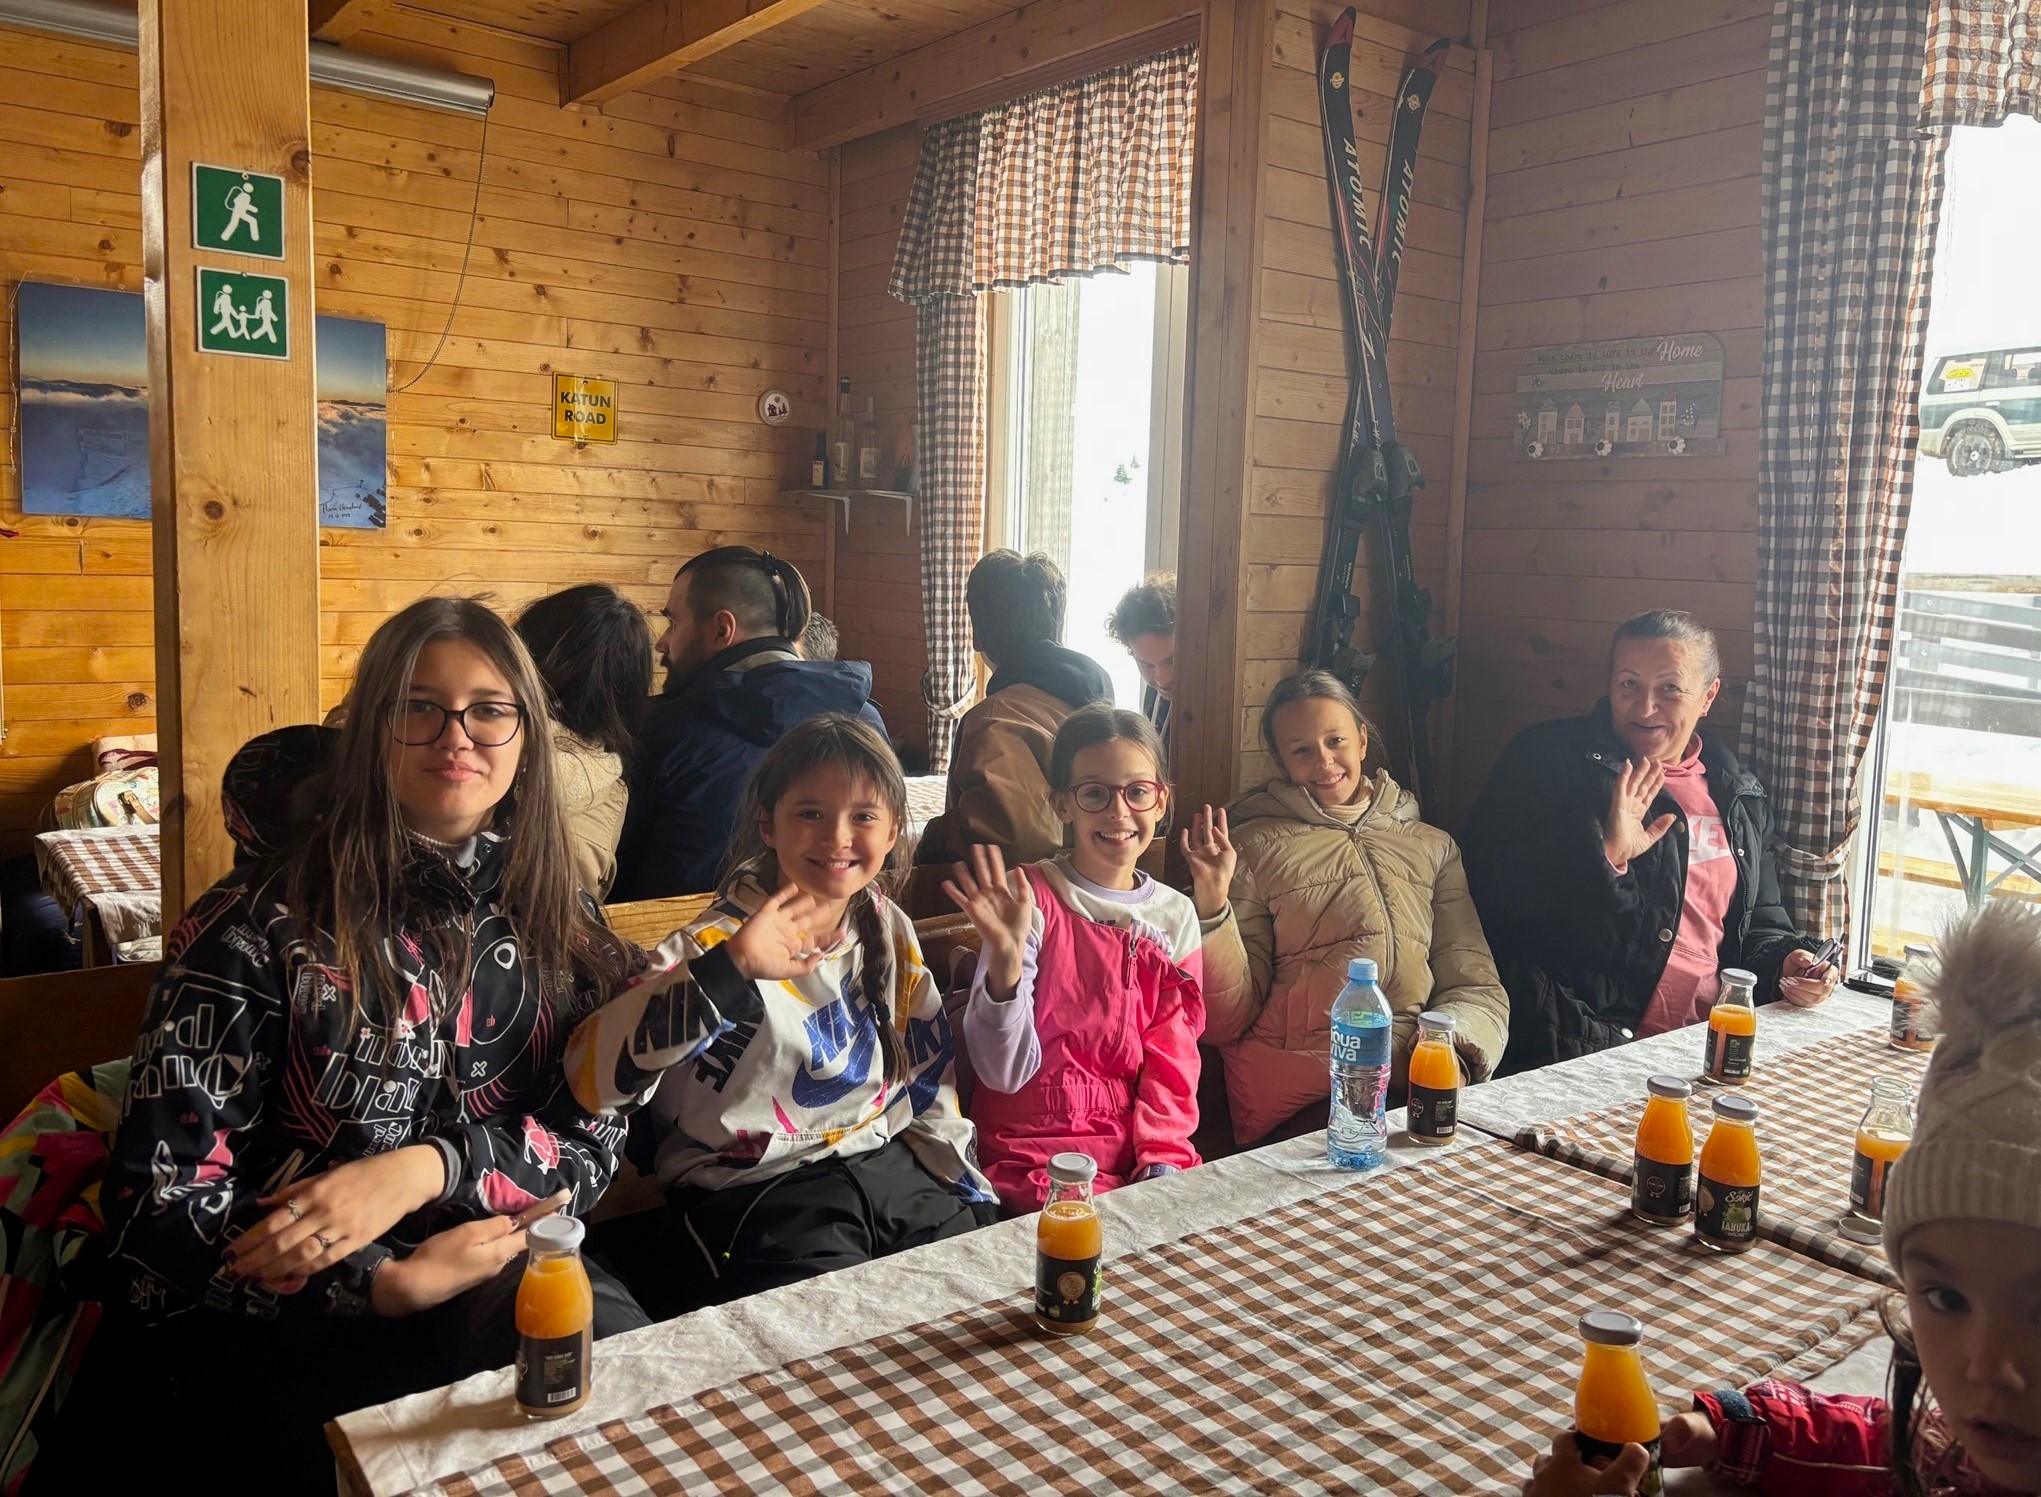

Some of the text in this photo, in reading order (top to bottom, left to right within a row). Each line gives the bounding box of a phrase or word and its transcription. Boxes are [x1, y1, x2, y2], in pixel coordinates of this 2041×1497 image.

[1343, 137, 1371, 250] ATOMIC
[1391, 158, 1412, 266] ATOMIC
[1655, 340, 1704, 362] Home
[1601, 372, 1644, 392] Heart
[560, 391, 611, 408] KATUN
[564, 410, 607, 425] ROAD
[633, 979, 723, 1056] NIK
[1331, 1032, 1361, 1050] qua
